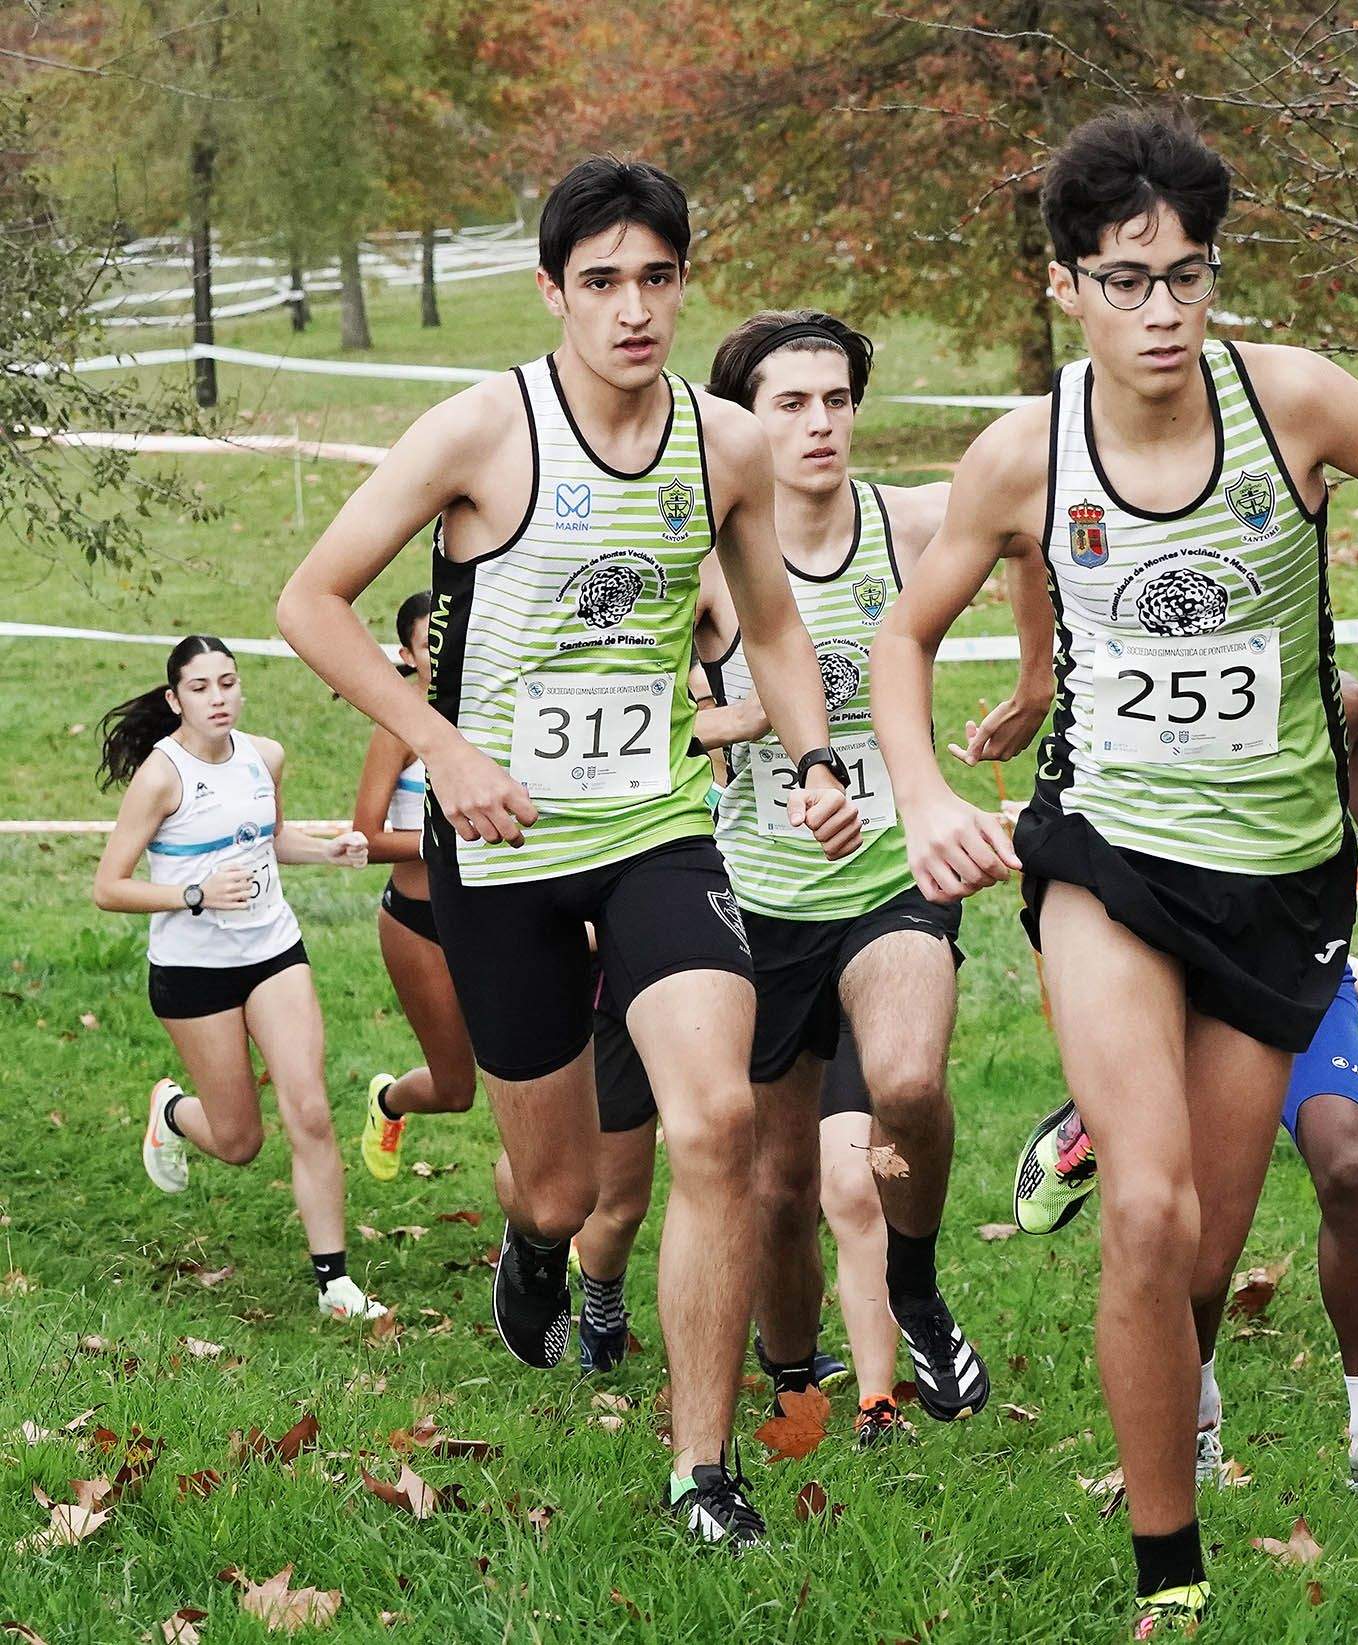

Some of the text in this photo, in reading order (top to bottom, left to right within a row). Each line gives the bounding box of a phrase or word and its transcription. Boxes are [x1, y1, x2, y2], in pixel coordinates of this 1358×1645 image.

[555, 520, 590, 532] MARÍN
[1110, 576, 1135, 622] Comunidade
[1133, 566, 1145, 577] de
[1144, 551, 1179, 570] Montes
[604, 635, 616, 646] de
[617, 634, 655, 647] Piñeiro
[814, 640, 832, 650] ontes
[1117, 665, 1256, 724] 253
[534, 704, 652, 760] 312
[829, 713, 841, 723] de
[771, 758, 875, 808] 31
